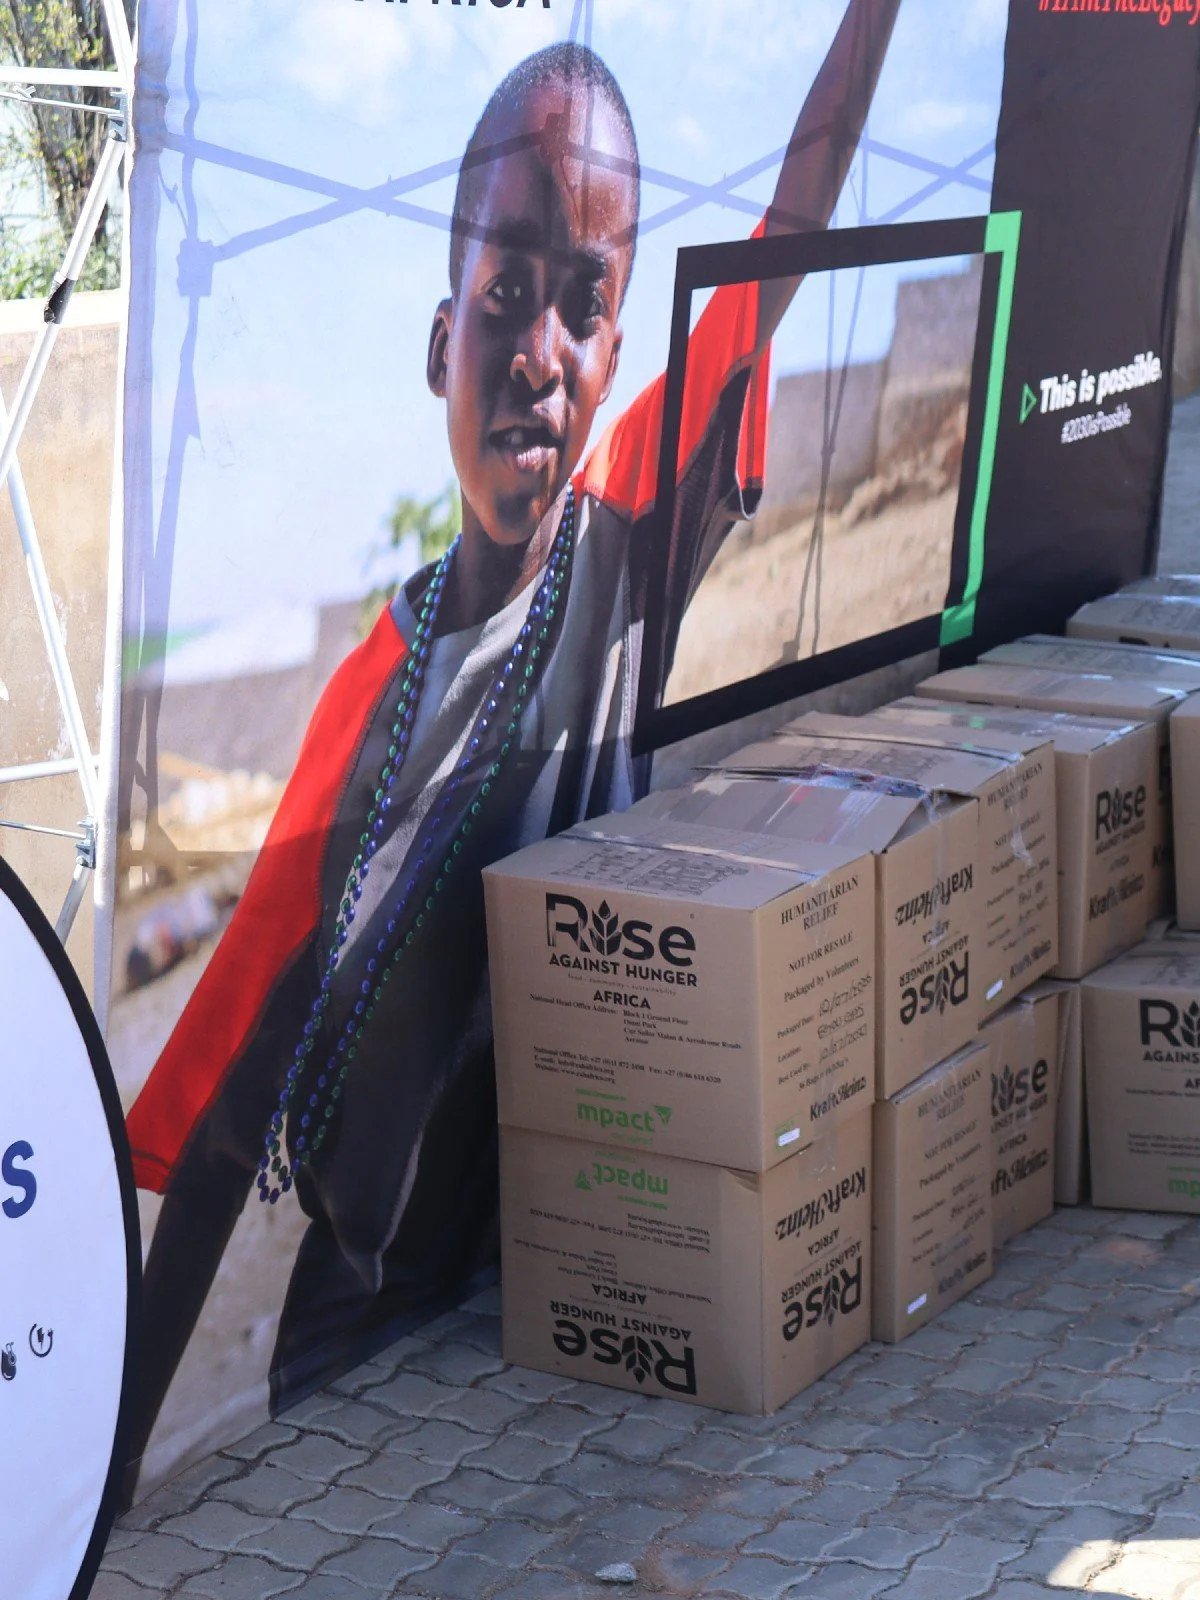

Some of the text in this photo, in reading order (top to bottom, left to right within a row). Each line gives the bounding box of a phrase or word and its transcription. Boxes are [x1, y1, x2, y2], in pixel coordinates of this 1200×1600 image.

[1040, 374, 1077, 413] This
[1078, 368, 1096, 403] is
[781, 875, 859, 925] HUMANITARIAN
[803, 901, 839, 931] RELIEF
[545, 892, 696, 967] Rise
[549, 952, 698, 987] AGAINST HUNGER
[788, 931, 854, 973] NOT FOR RESALE
[594, 990, 651, 1009] AFRICA
[784, 977, 815, 1003] Packaged
[825, 955, 860, 980] Volunteers
[576, 1102, 655, 1133] mpact
[807, 1226, 840, 1256] AFRICA
[781, 1240, 862, 1303] AGAINST HUNGER
[592, 1283, 647, 1305] AFRICA
[550, 1300, 692, 1341] AGAINST HUNGER
